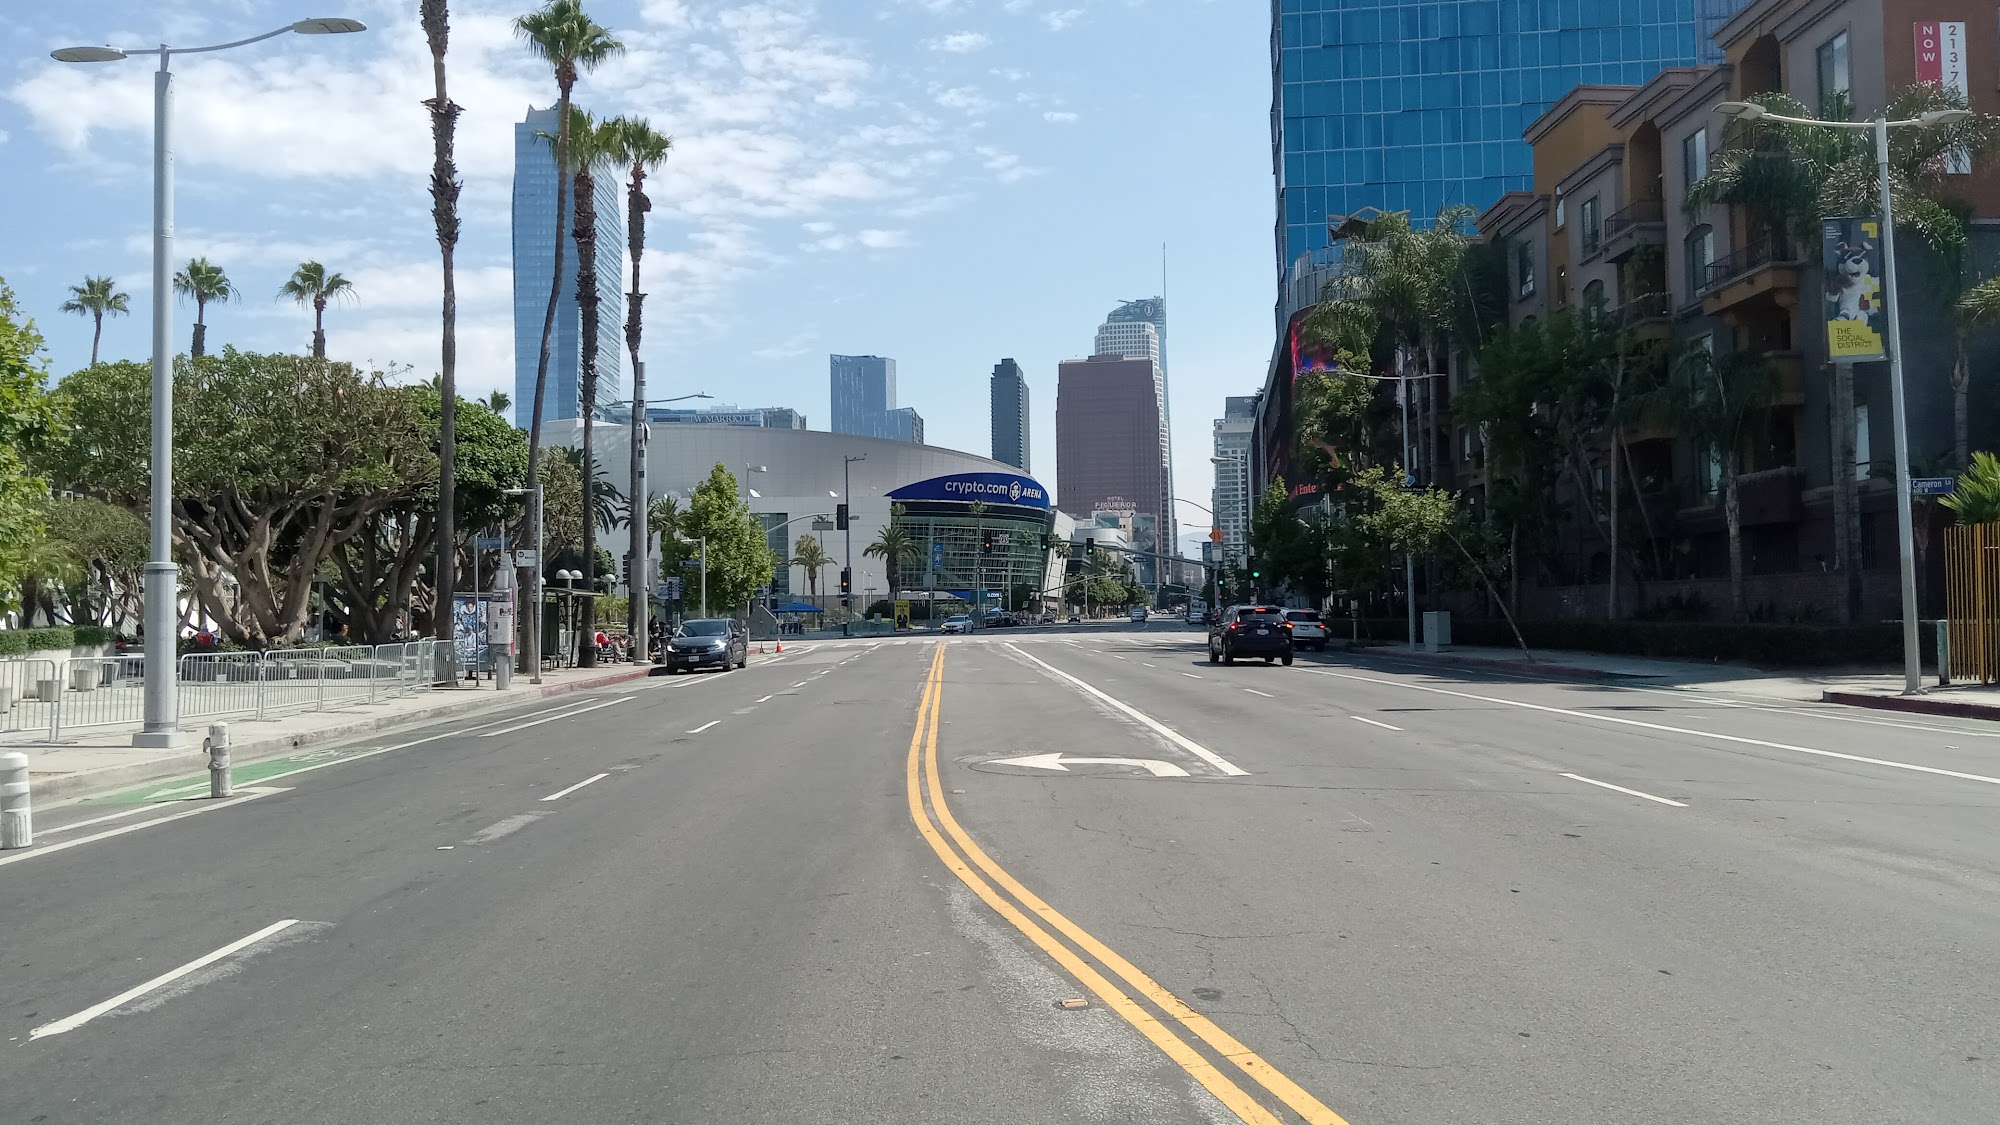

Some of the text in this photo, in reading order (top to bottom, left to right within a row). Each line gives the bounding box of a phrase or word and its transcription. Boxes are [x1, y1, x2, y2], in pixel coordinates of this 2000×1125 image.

[1922, 25, 1935, 62] NOW
[1836, 327, 1851, 335] THE
[1836, 334, 1865, 342] SOCIAL
[1837, 341, 1872, 349] DISTRICT
[705, 415, 754, 423] MARRIOTT
[1912, 480, 1942, 488] Cameron
[945, 481, 1042, 499] crypto.com ARENA
